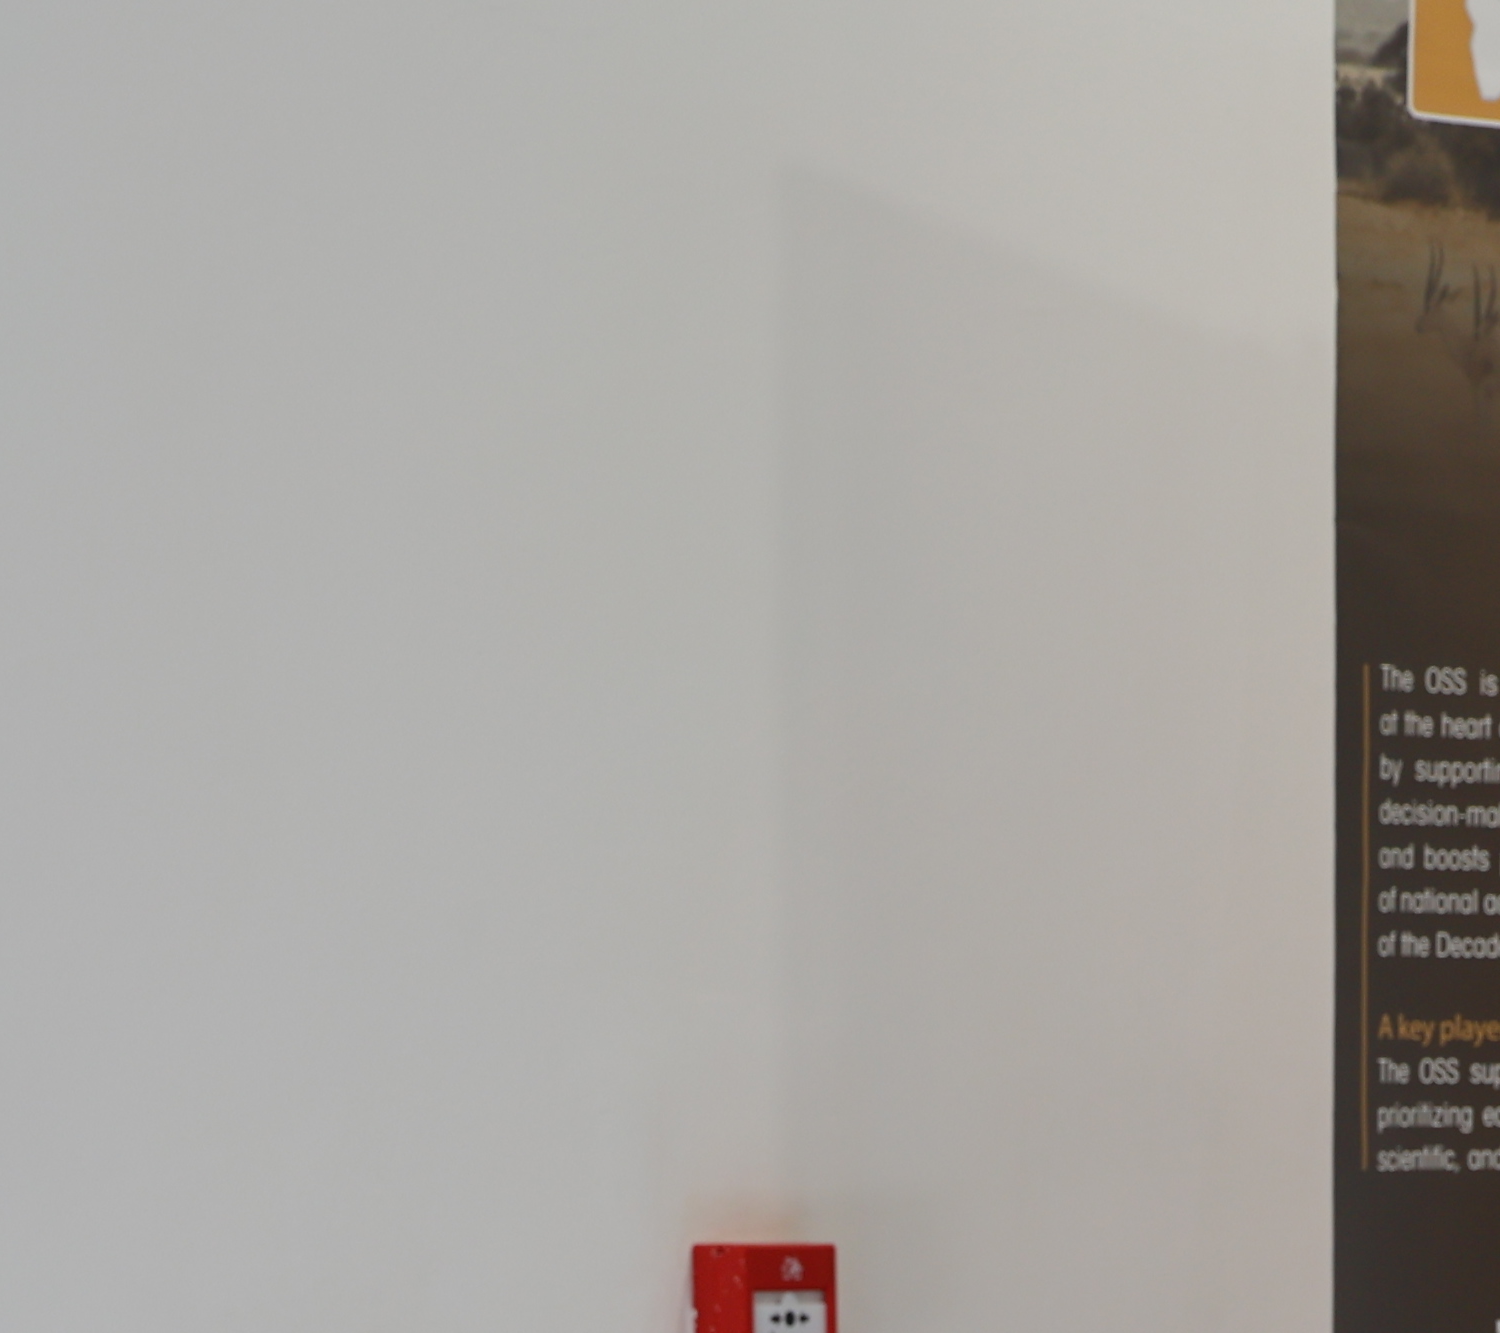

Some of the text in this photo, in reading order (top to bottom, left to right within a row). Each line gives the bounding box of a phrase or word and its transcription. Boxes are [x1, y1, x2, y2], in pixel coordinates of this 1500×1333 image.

[1380, 663, 1414, 691] The
[1423, 665, 1467, 694] OSS
[1478, 670, 1498, 696] is
[1379, 710, 1398, 735] at
[1403, 711, 1434, 736] the
[1440, 713, 1492, 739] heart
[1378, 754, 1402, 784] by
[1378, 843, 1415, 869] and
[1422, 844, 1490, 870] boosts
[1399, 888, 1478, 914] national
[1400, 932, 1430, 956] the
[1377, 1014, 1393, 1038] A
[1397, 1014, 1434, 1045] key
[1377, 1057, 1410, 1083] The
[1417, 1057, 1460, 1084] OSS
[1376, 1104, 1474, 1133] prioritizing
